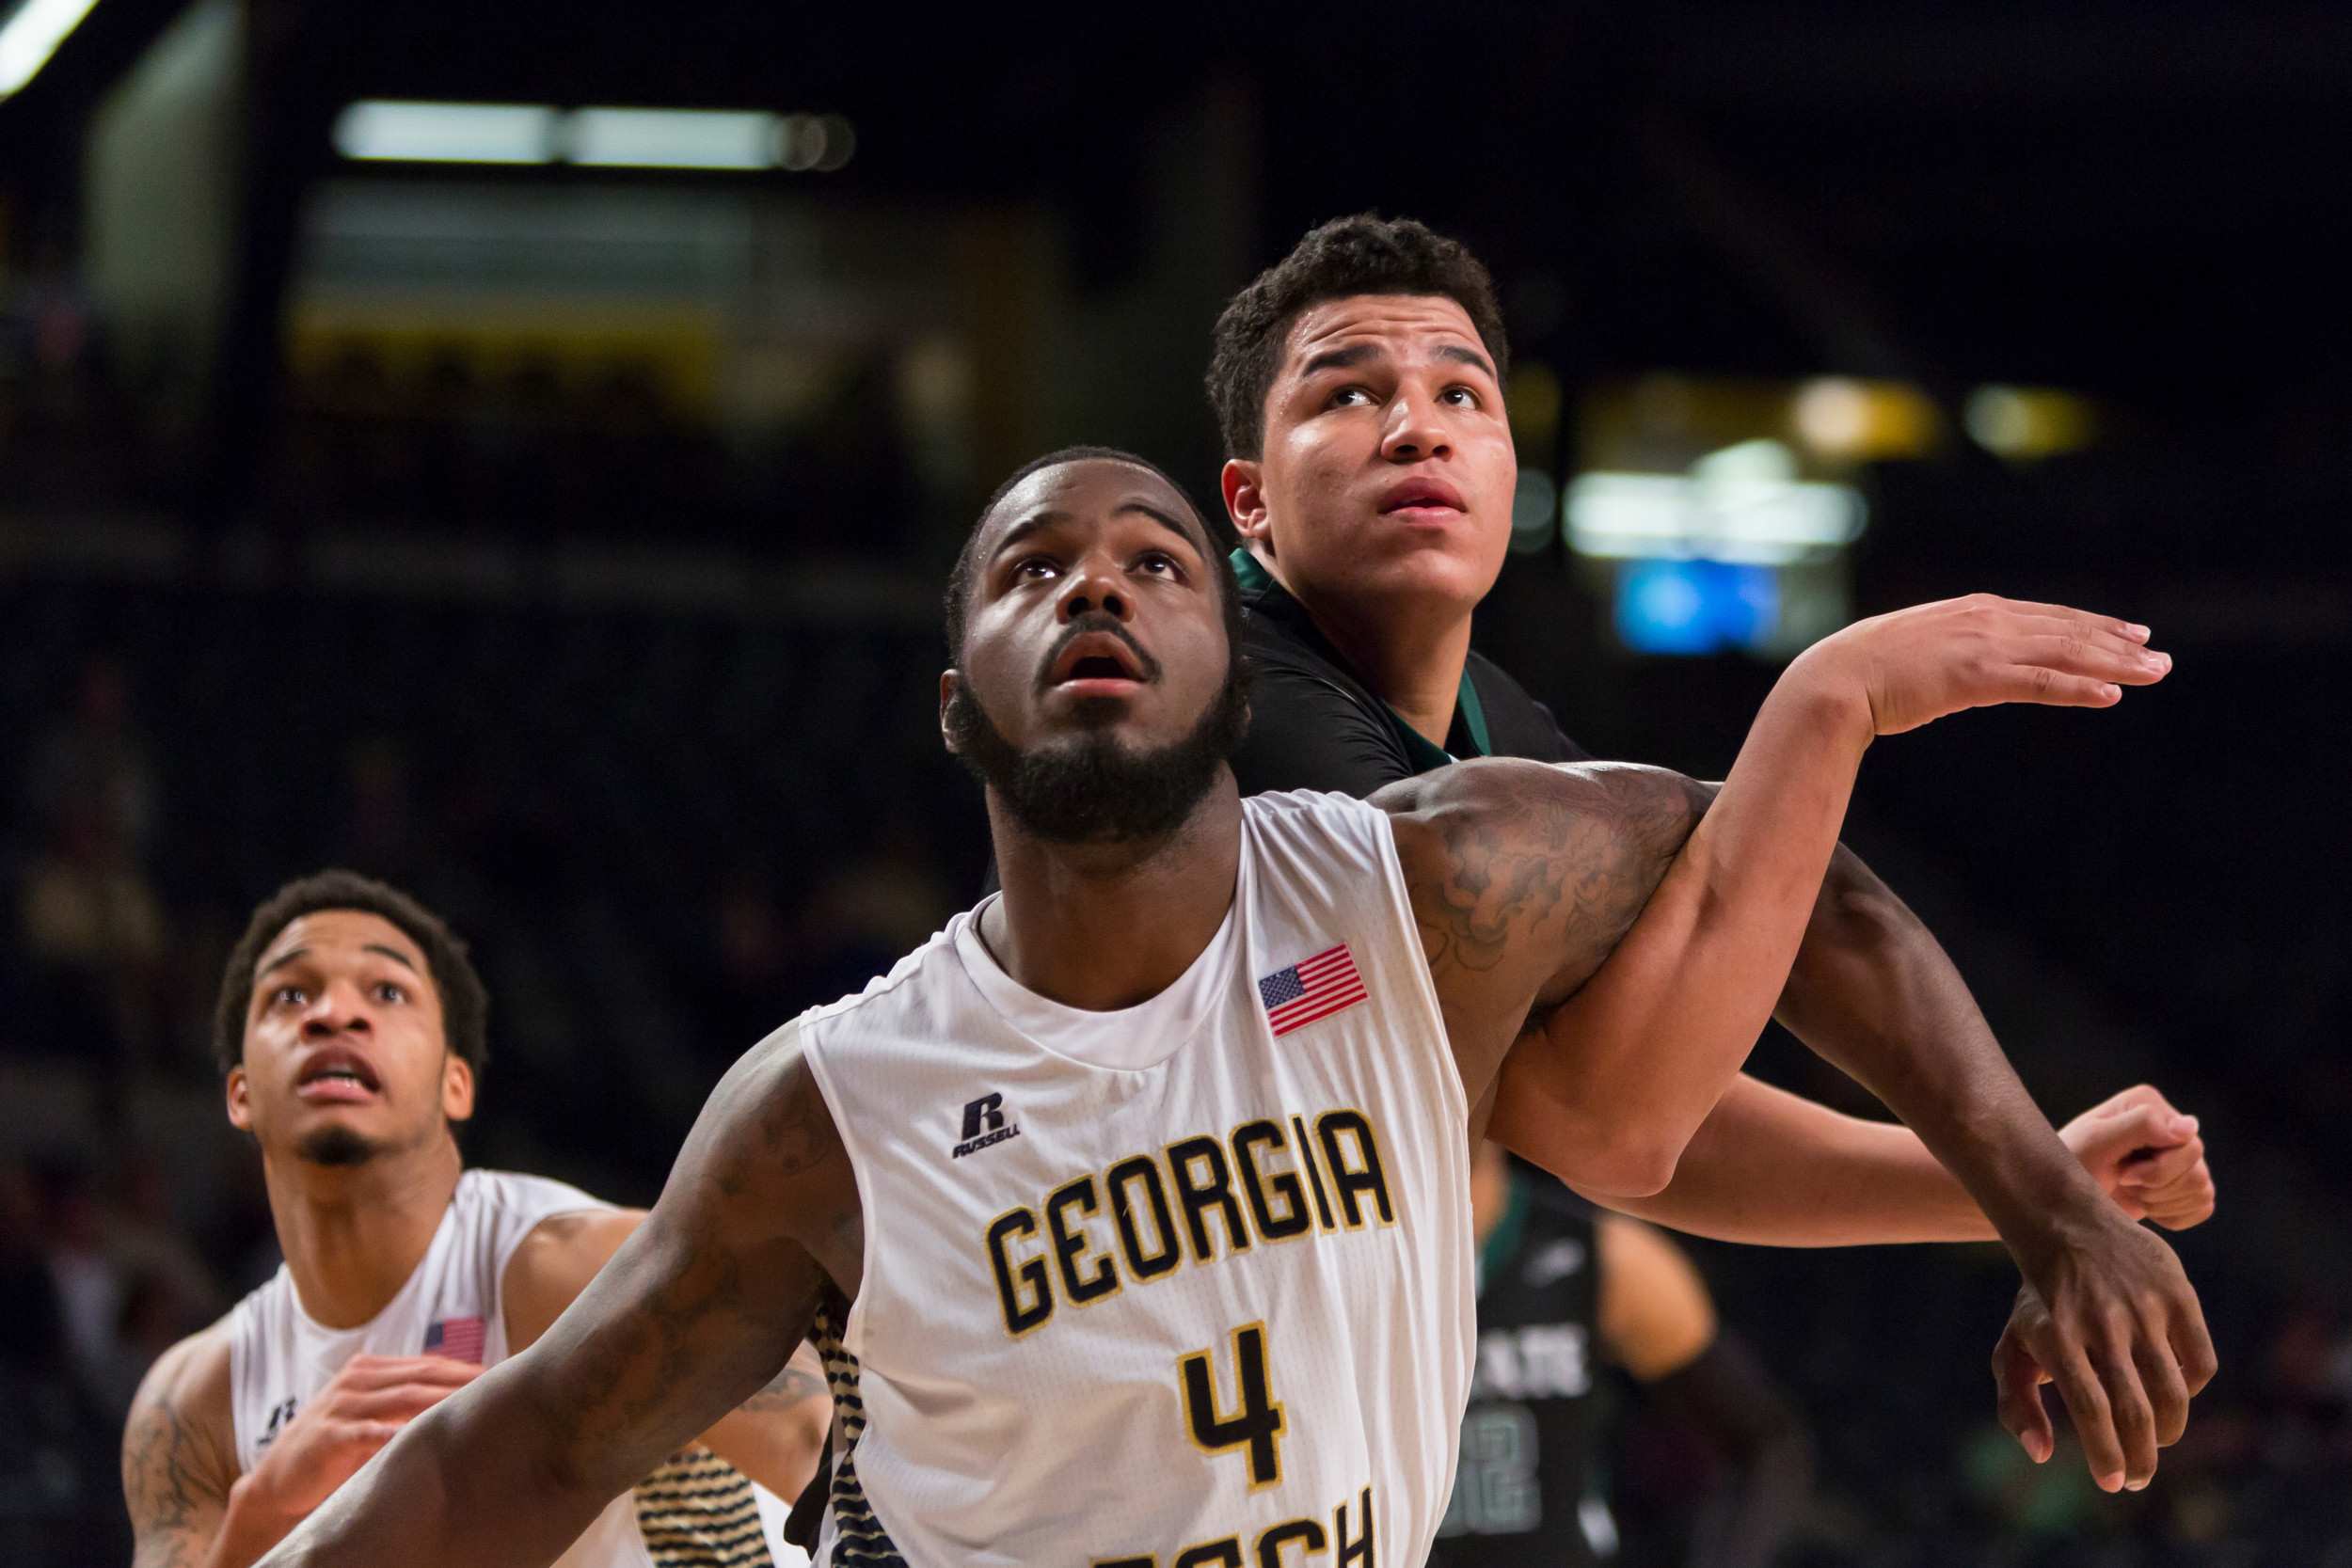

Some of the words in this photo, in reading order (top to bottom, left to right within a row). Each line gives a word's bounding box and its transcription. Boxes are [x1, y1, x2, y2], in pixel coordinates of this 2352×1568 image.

[952, 1123, 1020, 1159] RUSSELL
[961, 1092, 1004, 1141] R
[986, 1109, 1394, 1337] GEORGIA
[1176, 1320, 1288, 1495] 4
